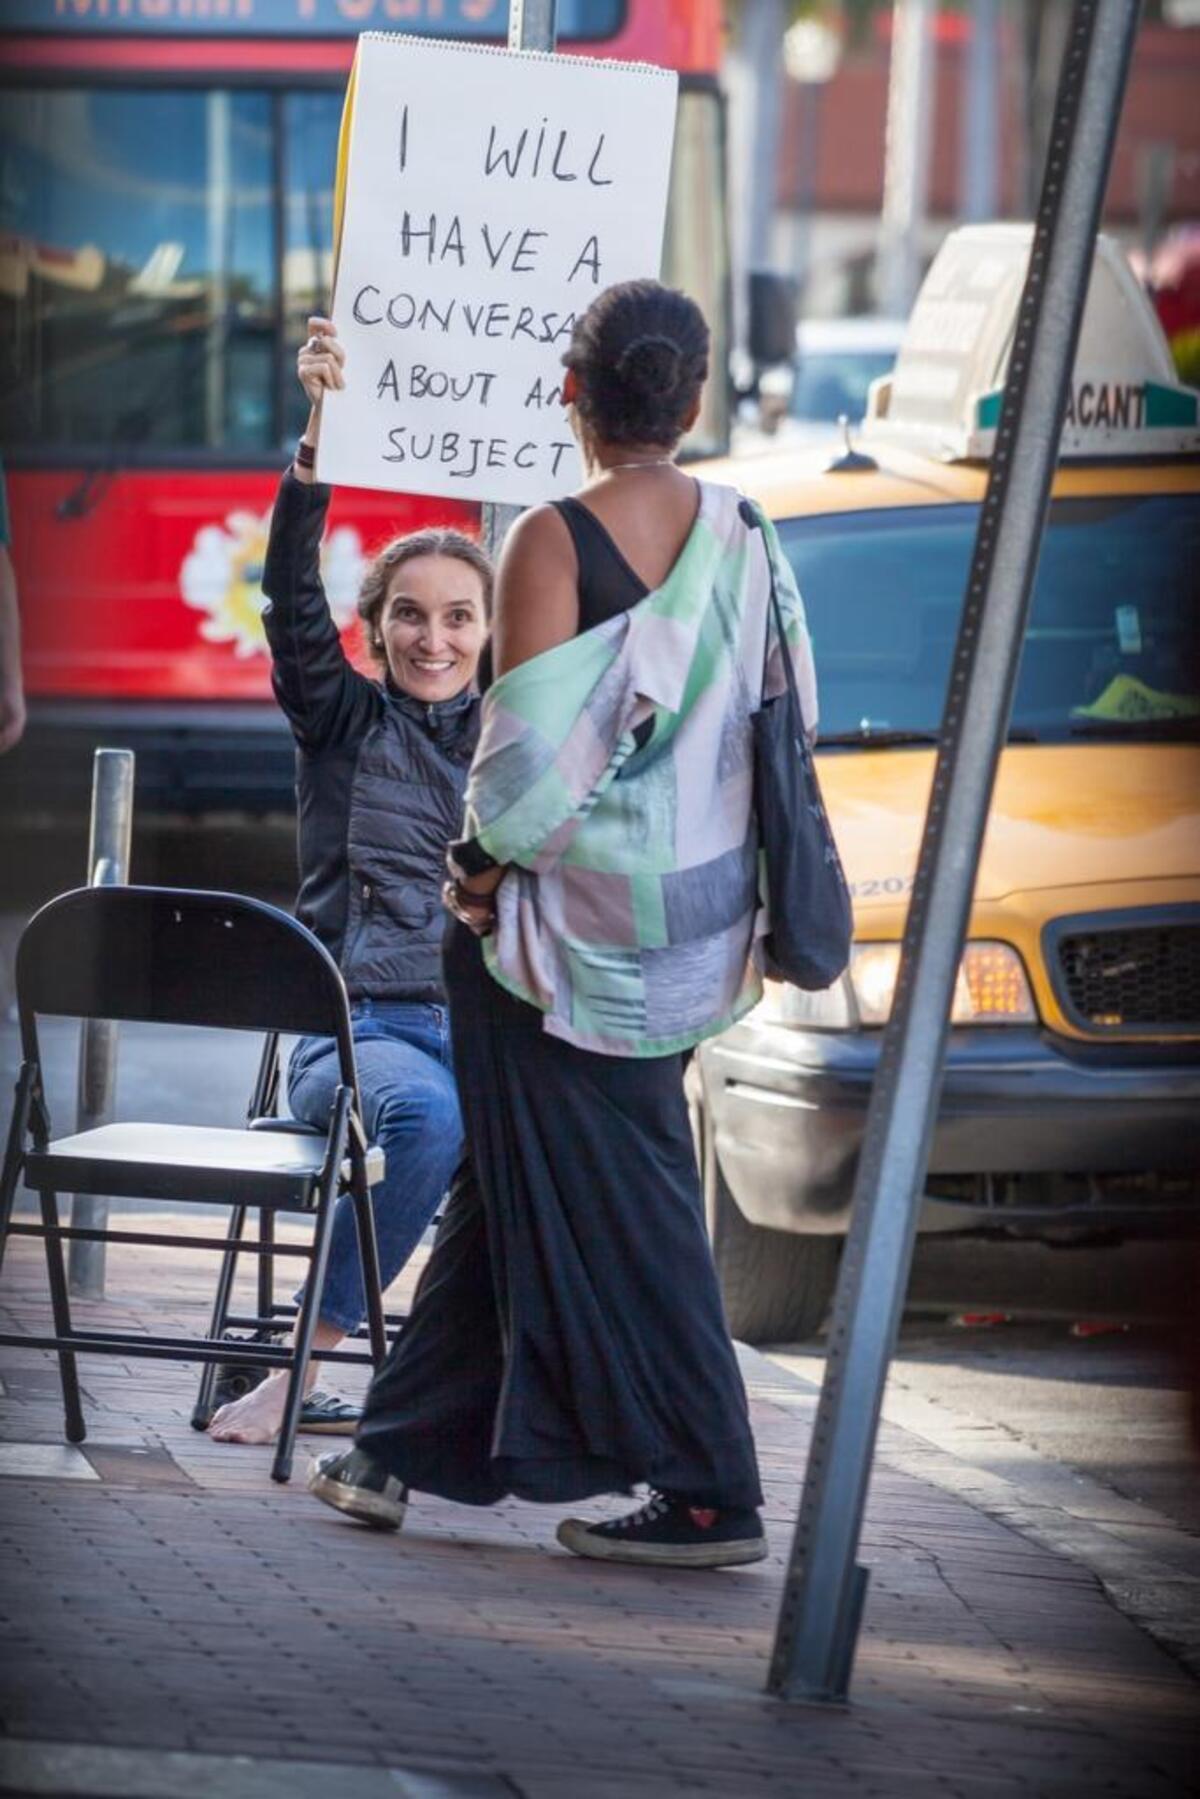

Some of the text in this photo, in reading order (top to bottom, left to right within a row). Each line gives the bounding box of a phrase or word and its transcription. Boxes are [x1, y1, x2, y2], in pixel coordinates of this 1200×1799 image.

[400, 104, 408, 172] I
[401, 211, 603, 284] HAVE A
[353, 285, 576, 343] CONVERSA
[377, 360, 496, 404] ABOUT
[381, 427, 575, 477] SUBJECT
